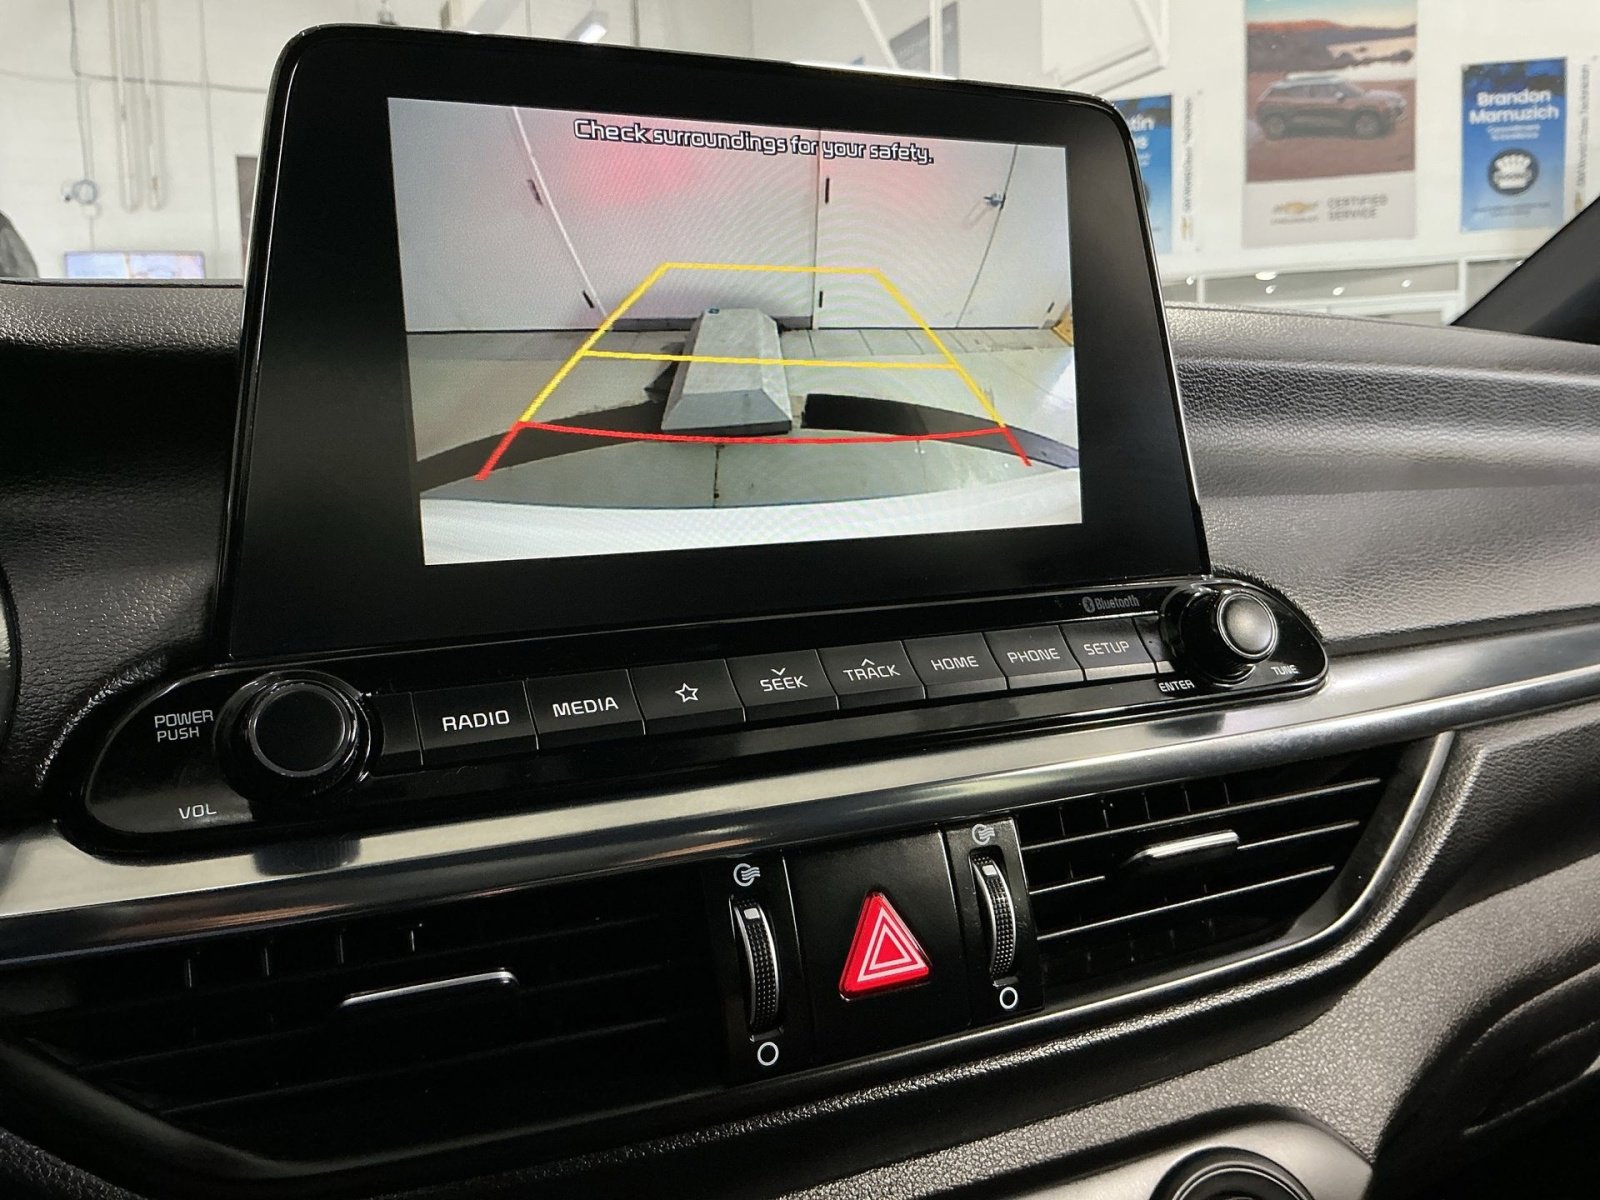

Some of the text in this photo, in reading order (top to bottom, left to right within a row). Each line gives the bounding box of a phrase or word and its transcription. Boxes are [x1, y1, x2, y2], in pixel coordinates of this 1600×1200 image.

[1477, 88, 1552, 107] Brandon
[573, 118, 934, 165] Check surroundings for your safety.
[1095, 595, 1140, 609] Bluetooth
[1007, 648, 1061, 664] PHONE
[1083, 640, 1130, 656] SETUP
[930, 655, 979, 672] HOME
[1270, 664, 1299, 676] TUNE
[843, 664, 901, 682] TRACK
[759, 675, 808, 693] SEEK
[1158, 679, 1196, 693] ENTER
[552, 696, 620, 718] MEDIA
[154, 709, 214, 729] POWER
[441, 709, 511, 732] RADIO
[156, 726, 200, 743] PUSH
[178, 803, 217, 820] VOL
